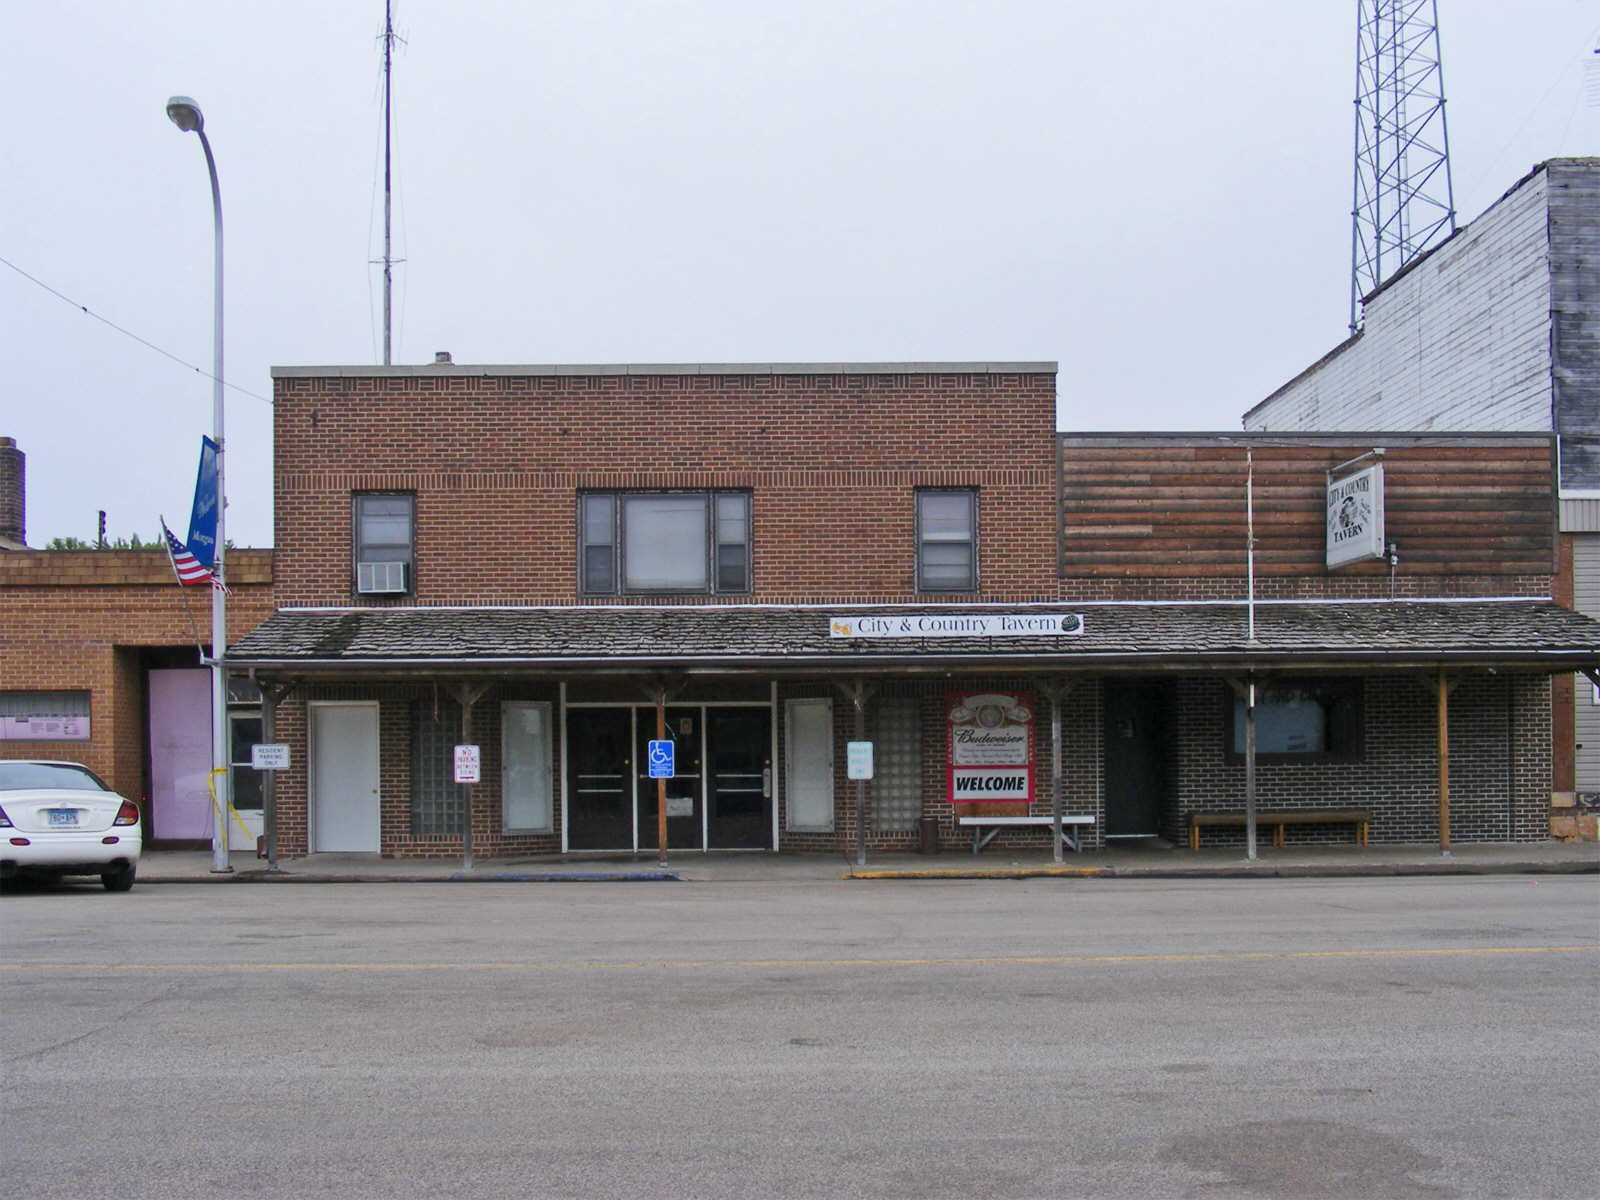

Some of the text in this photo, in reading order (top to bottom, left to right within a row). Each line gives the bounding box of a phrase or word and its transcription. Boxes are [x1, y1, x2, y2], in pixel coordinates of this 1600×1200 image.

[1328, 487, 1340, 507] CITY
[1345, 474, 1370, 496] COUNTRY
[192, 530, 214, 546] Morgan
[1334, 523, 1363, 543] TAVERN
[858, 616, 1057, 635] City & Country Tavern
[954, 729, 1026, 744] Budweiser
[956, 776, 1026, 791] WELCOME
